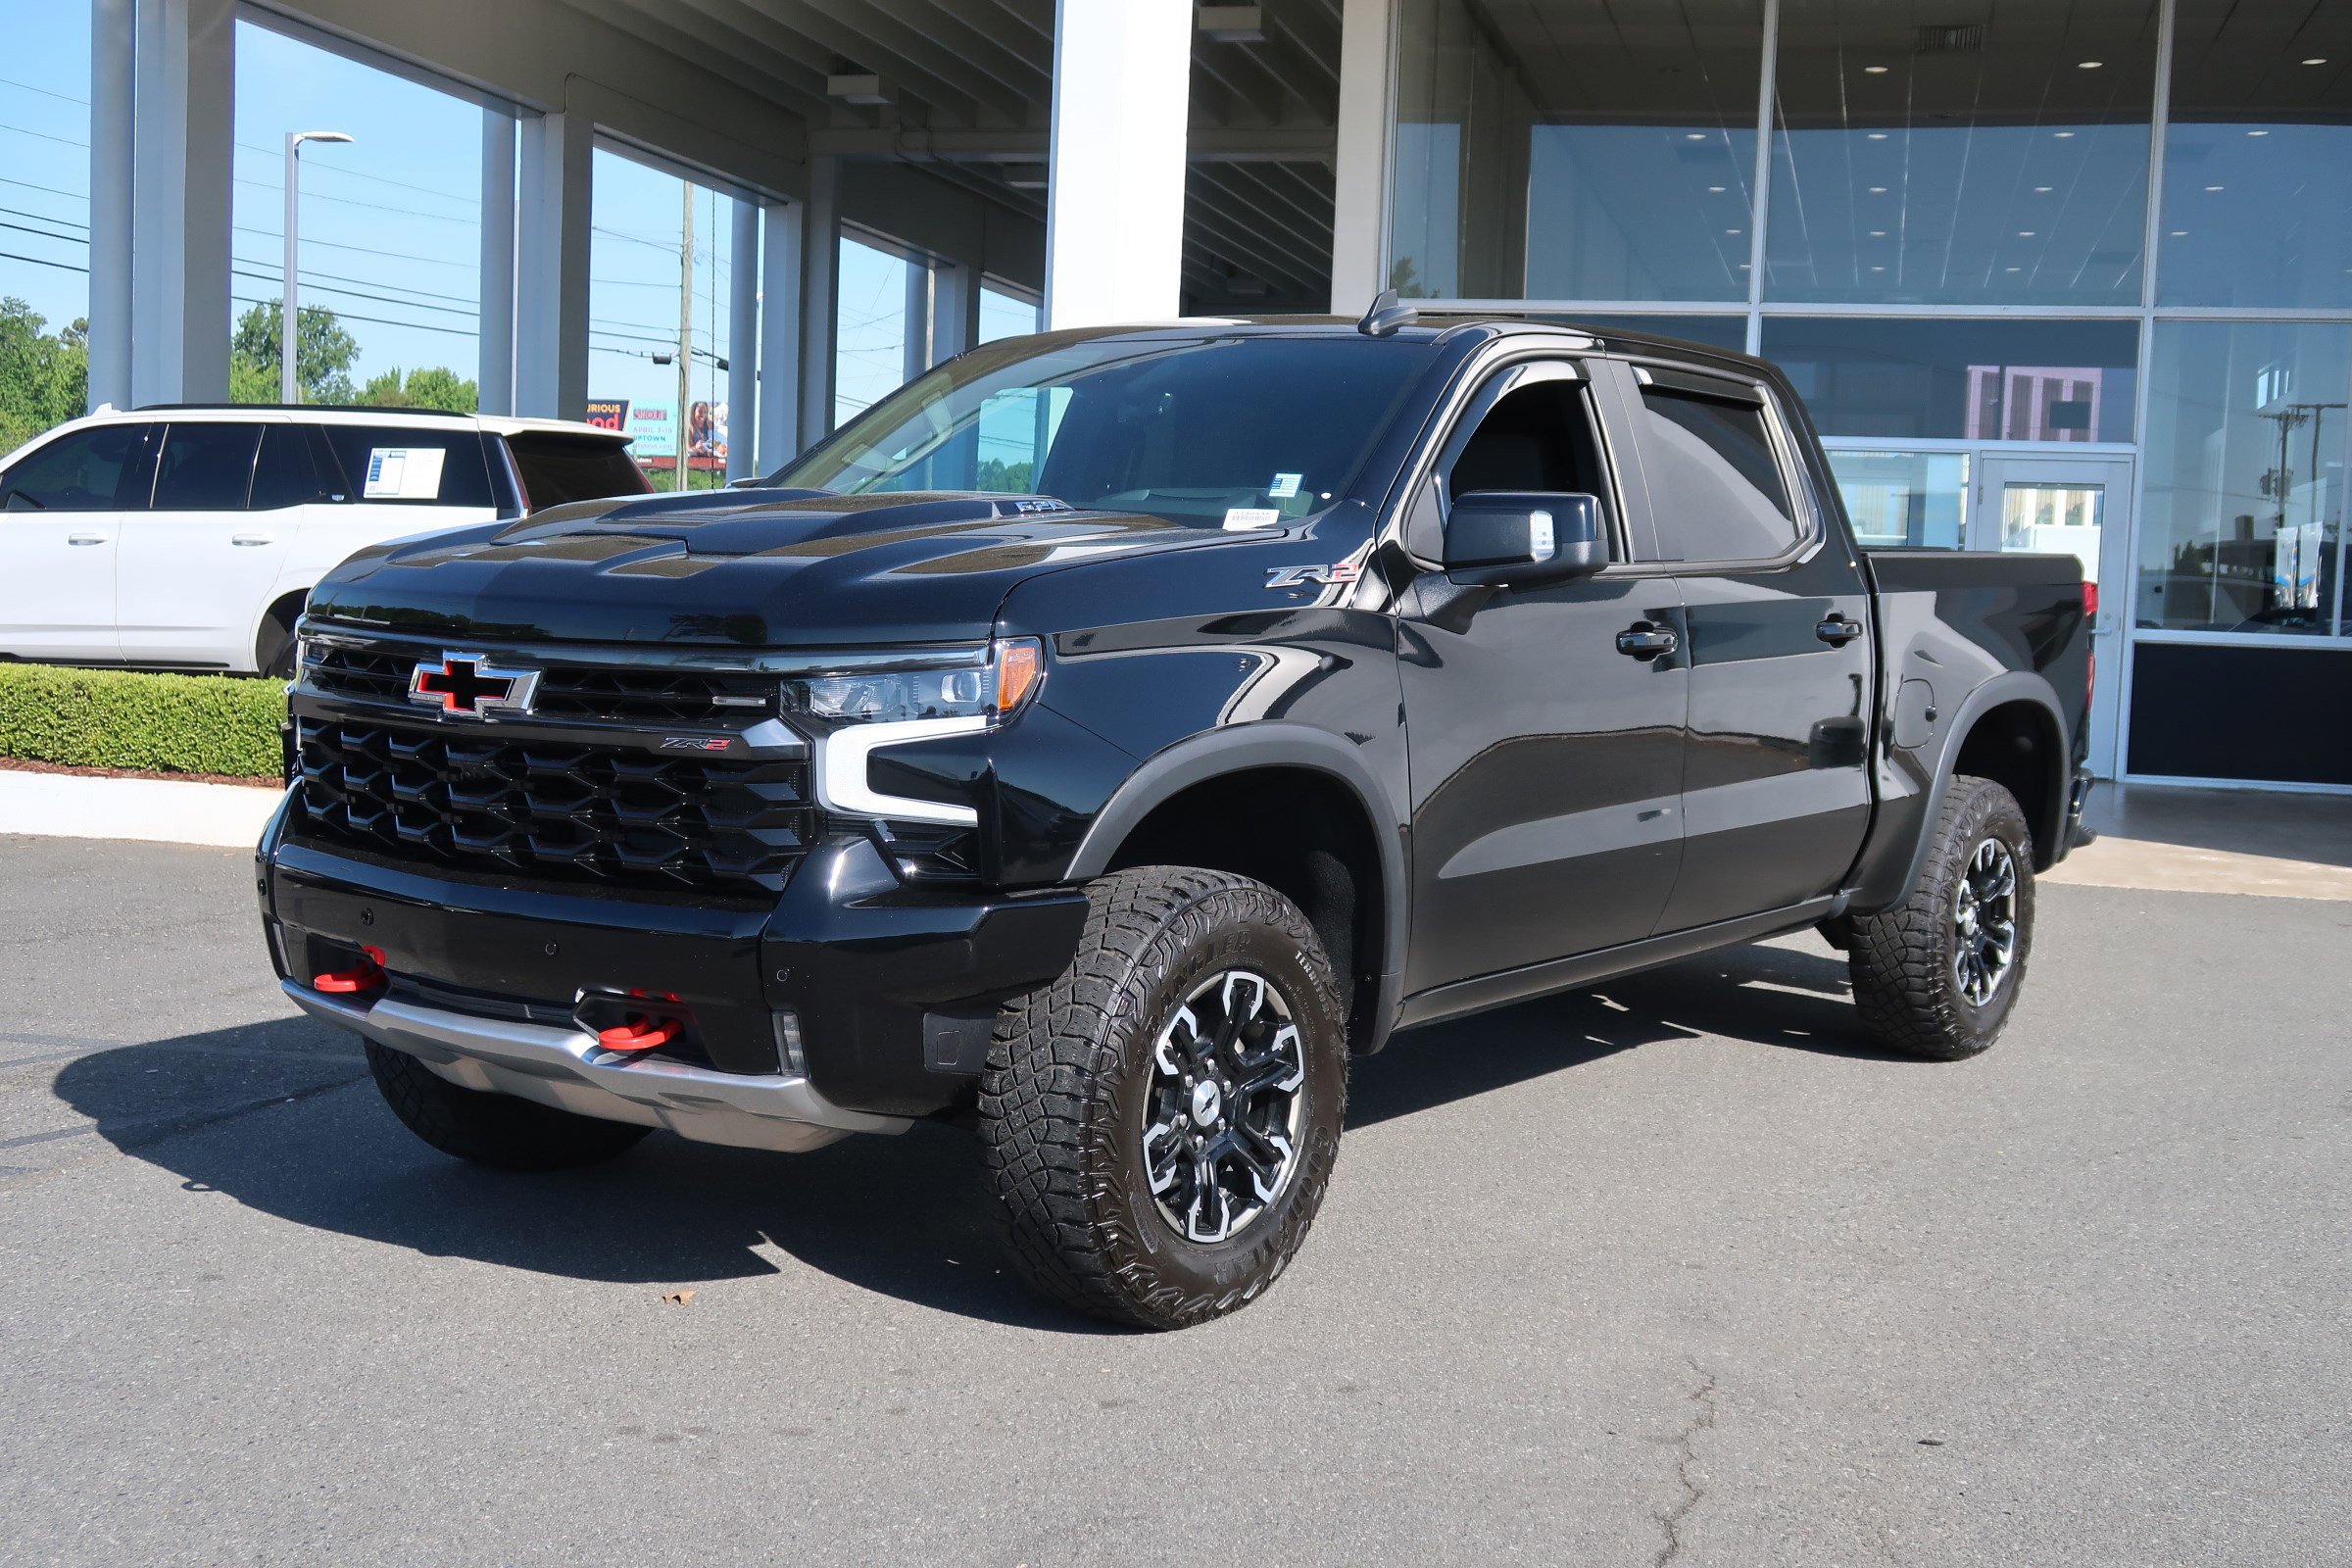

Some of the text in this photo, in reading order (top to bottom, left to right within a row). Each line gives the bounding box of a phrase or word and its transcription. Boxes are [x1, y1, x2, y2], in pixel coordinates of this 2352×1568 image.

[634, 409, 667, 420] SHOUT
[1264, 564, 1359, 588] ZR2
[660, 737, 732, 751] ZR2
